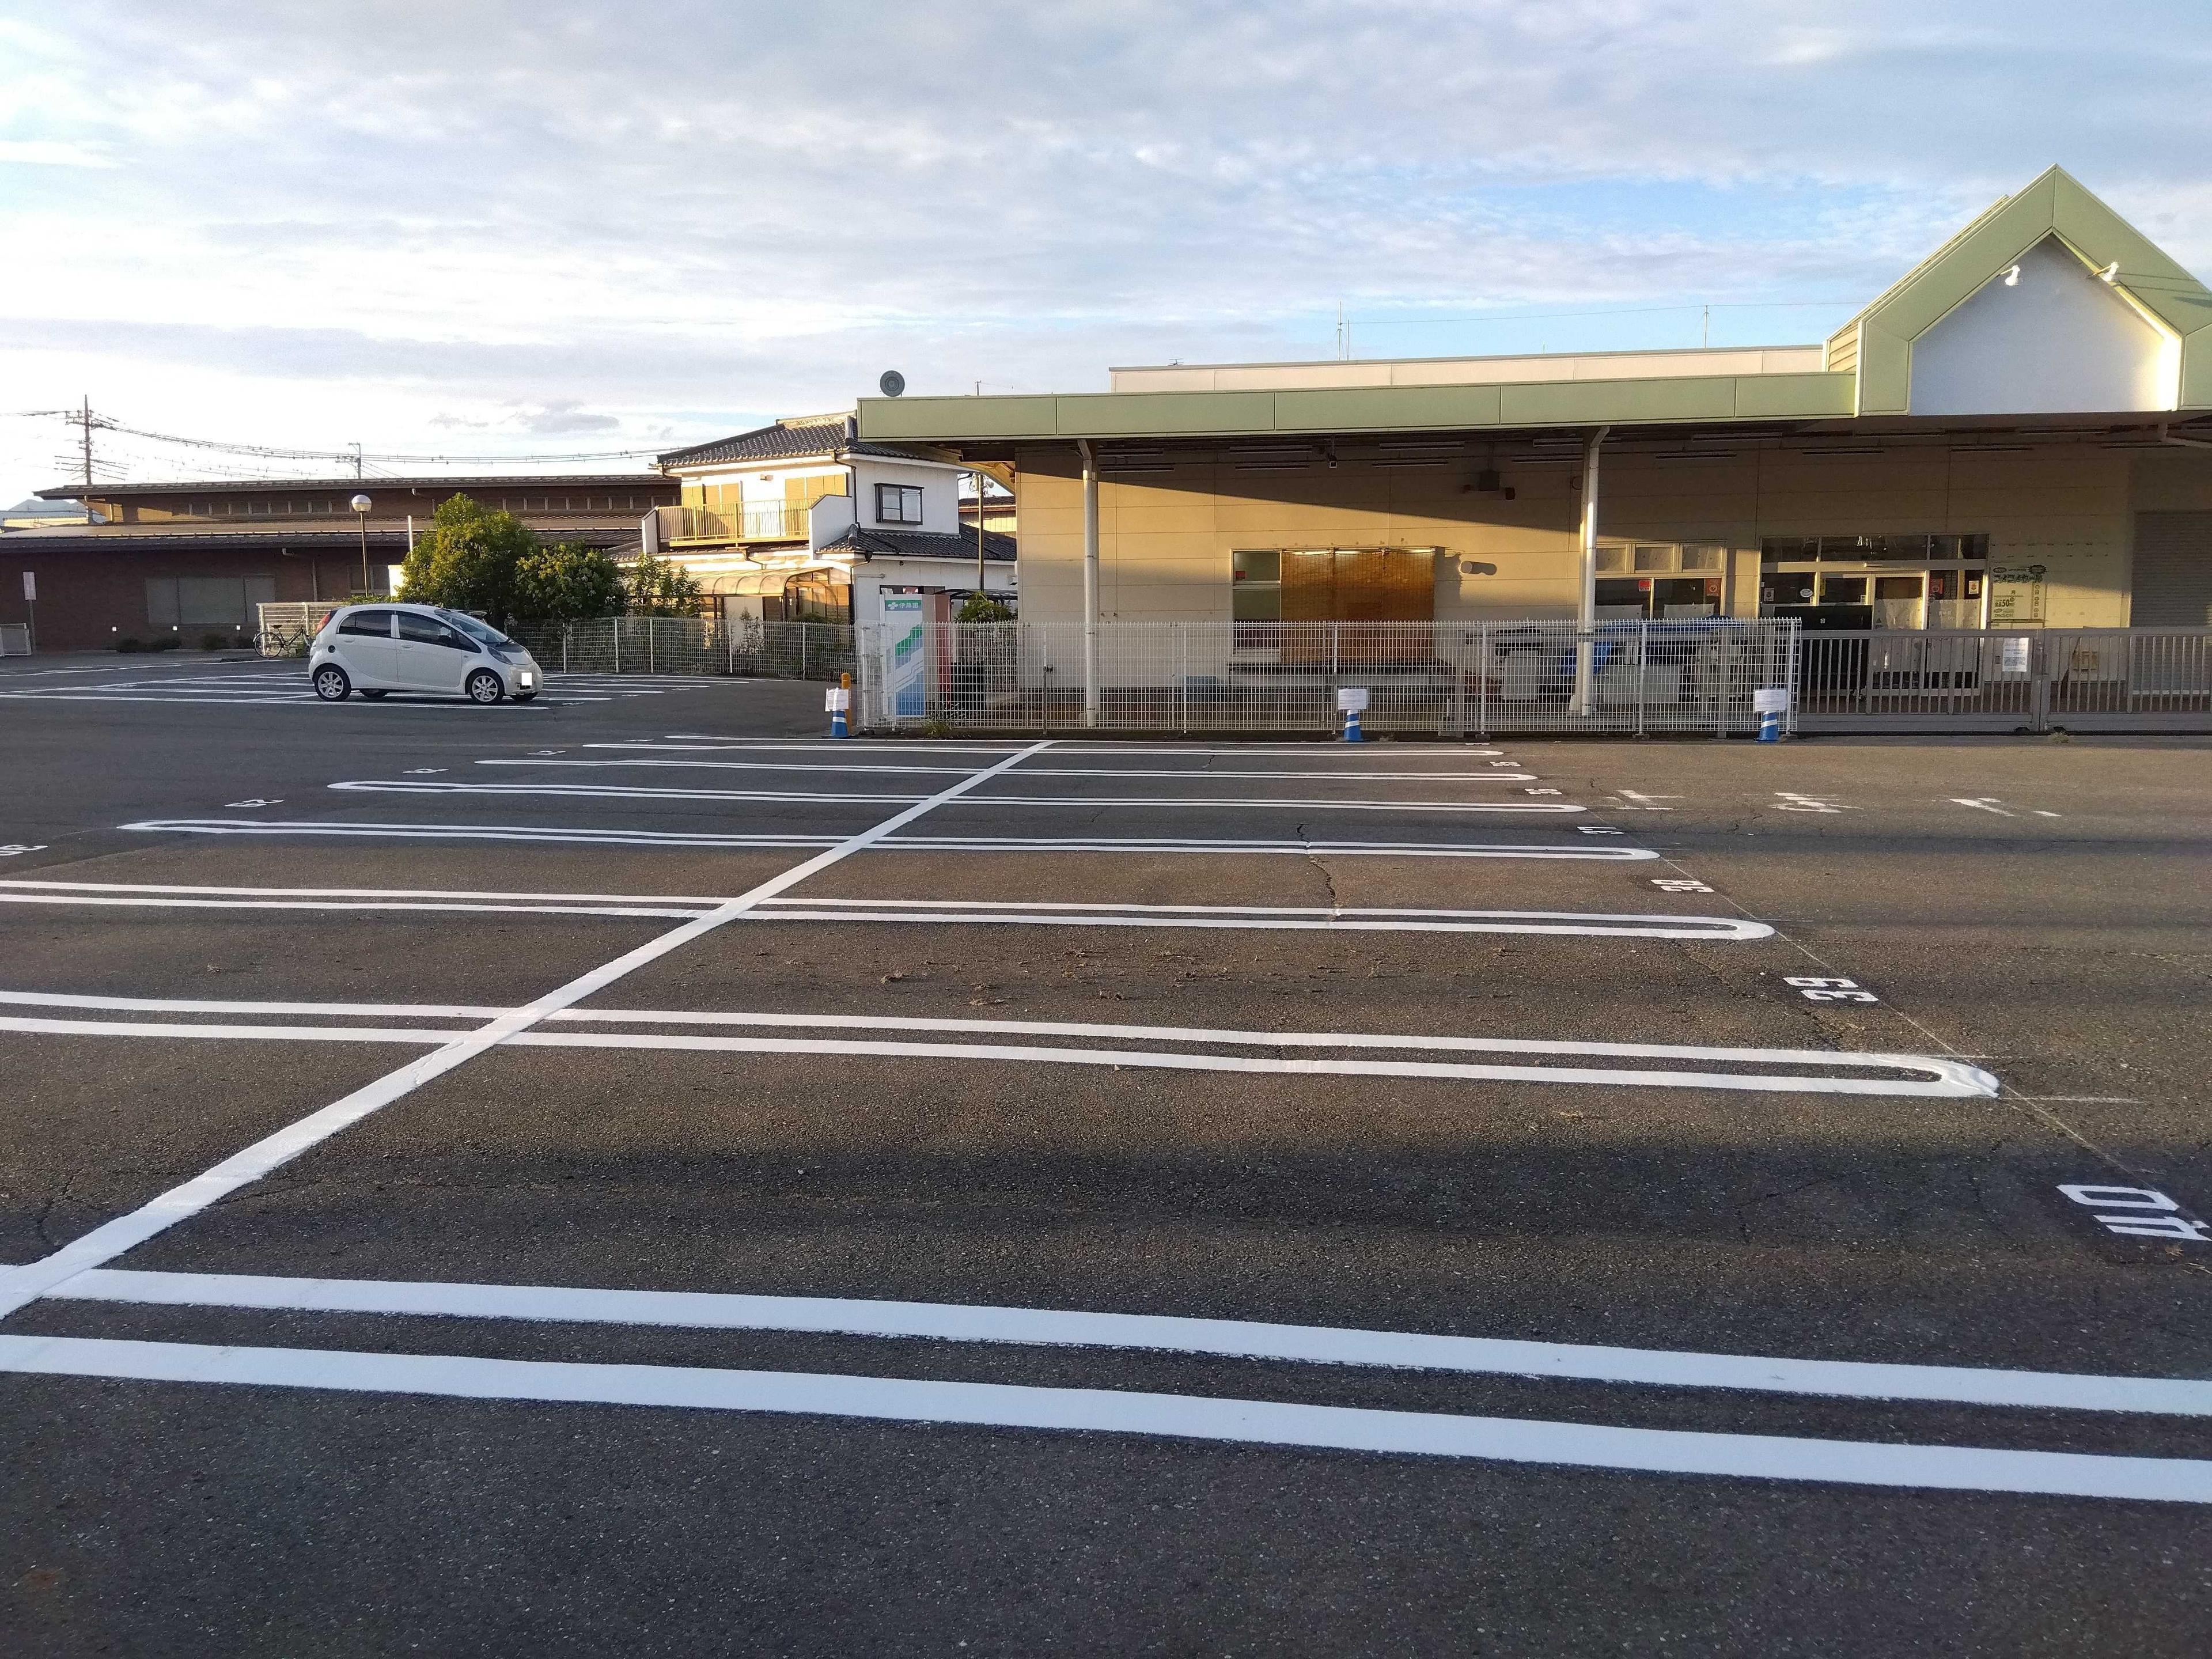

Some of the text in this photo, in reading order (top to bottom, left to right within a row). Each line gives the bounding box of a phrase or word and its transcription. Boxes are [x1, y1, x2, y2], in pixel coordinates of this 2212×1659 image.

[224, 799, 285, 807] 29
[1577, 826, 1624, 834] 37
[1651, 879, 1715, 892] 38
[1783, 976, 1879, 1002] 39
[2057, 1184, 2212, 1241] 40
